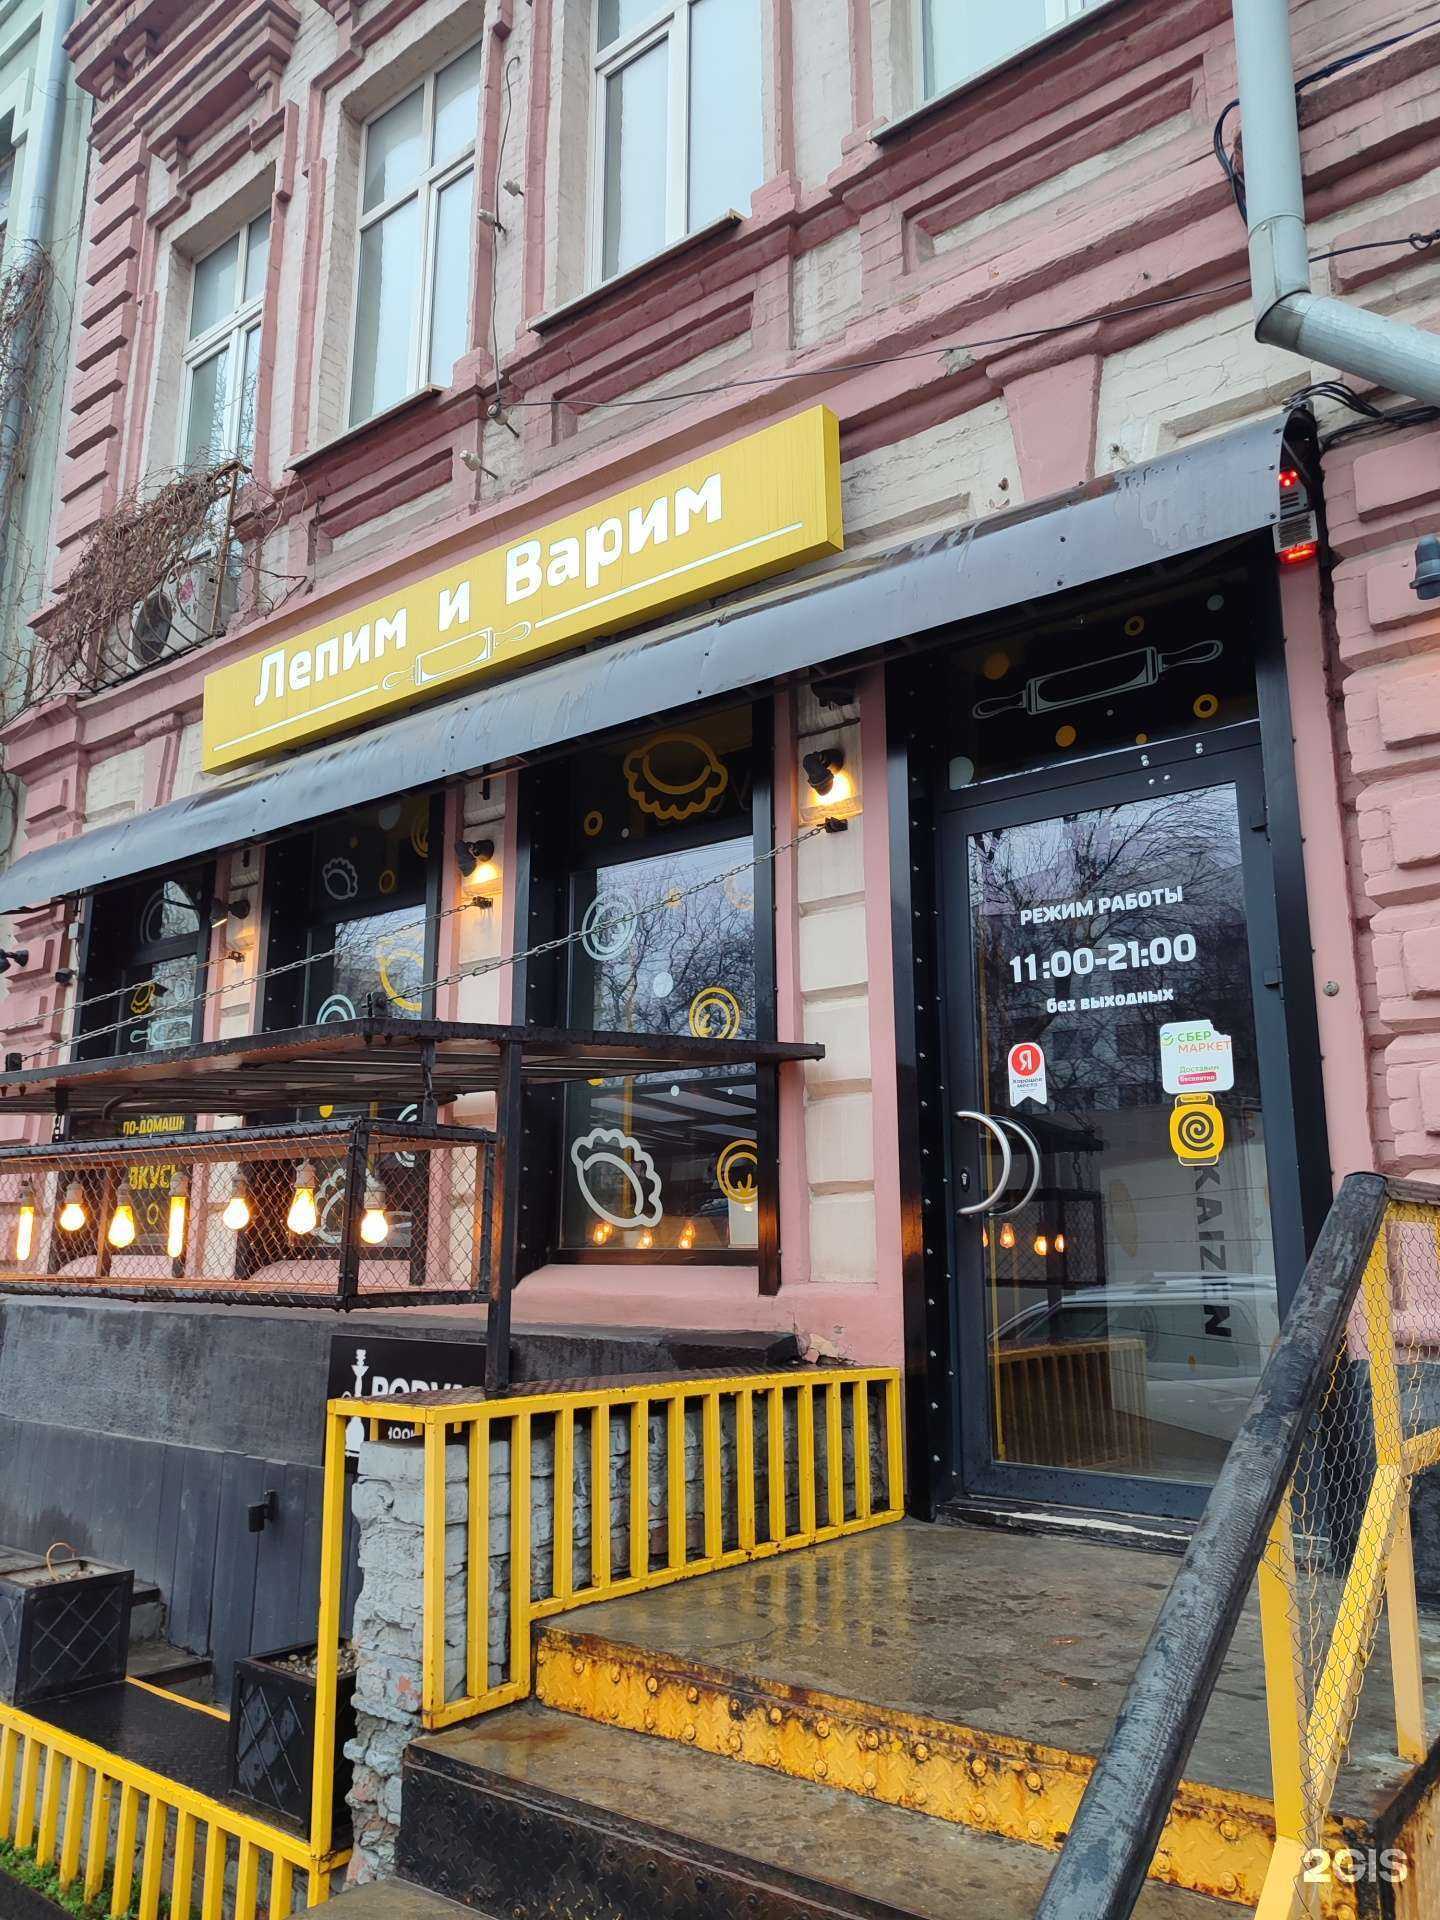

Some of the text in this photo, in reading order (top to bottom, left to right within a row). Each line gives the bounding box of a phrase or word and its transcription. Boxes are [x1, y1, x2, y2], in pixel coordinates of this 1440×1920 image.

[254, 472, 722, 708] Лепим и Варим
[1020, 886, 1183, 926] РЕЖИМ РАБОТЫ
[1009, 934, 1197, 983] 11:00-21:00
[1046, 988, 1174, 1014] без выходных
[1177, 1031, 1212, 1042] СБЕР
[1178, 1040, 1232, 1054] МАРКЕТ
[1018, 1050, 1033, 1071] Я
